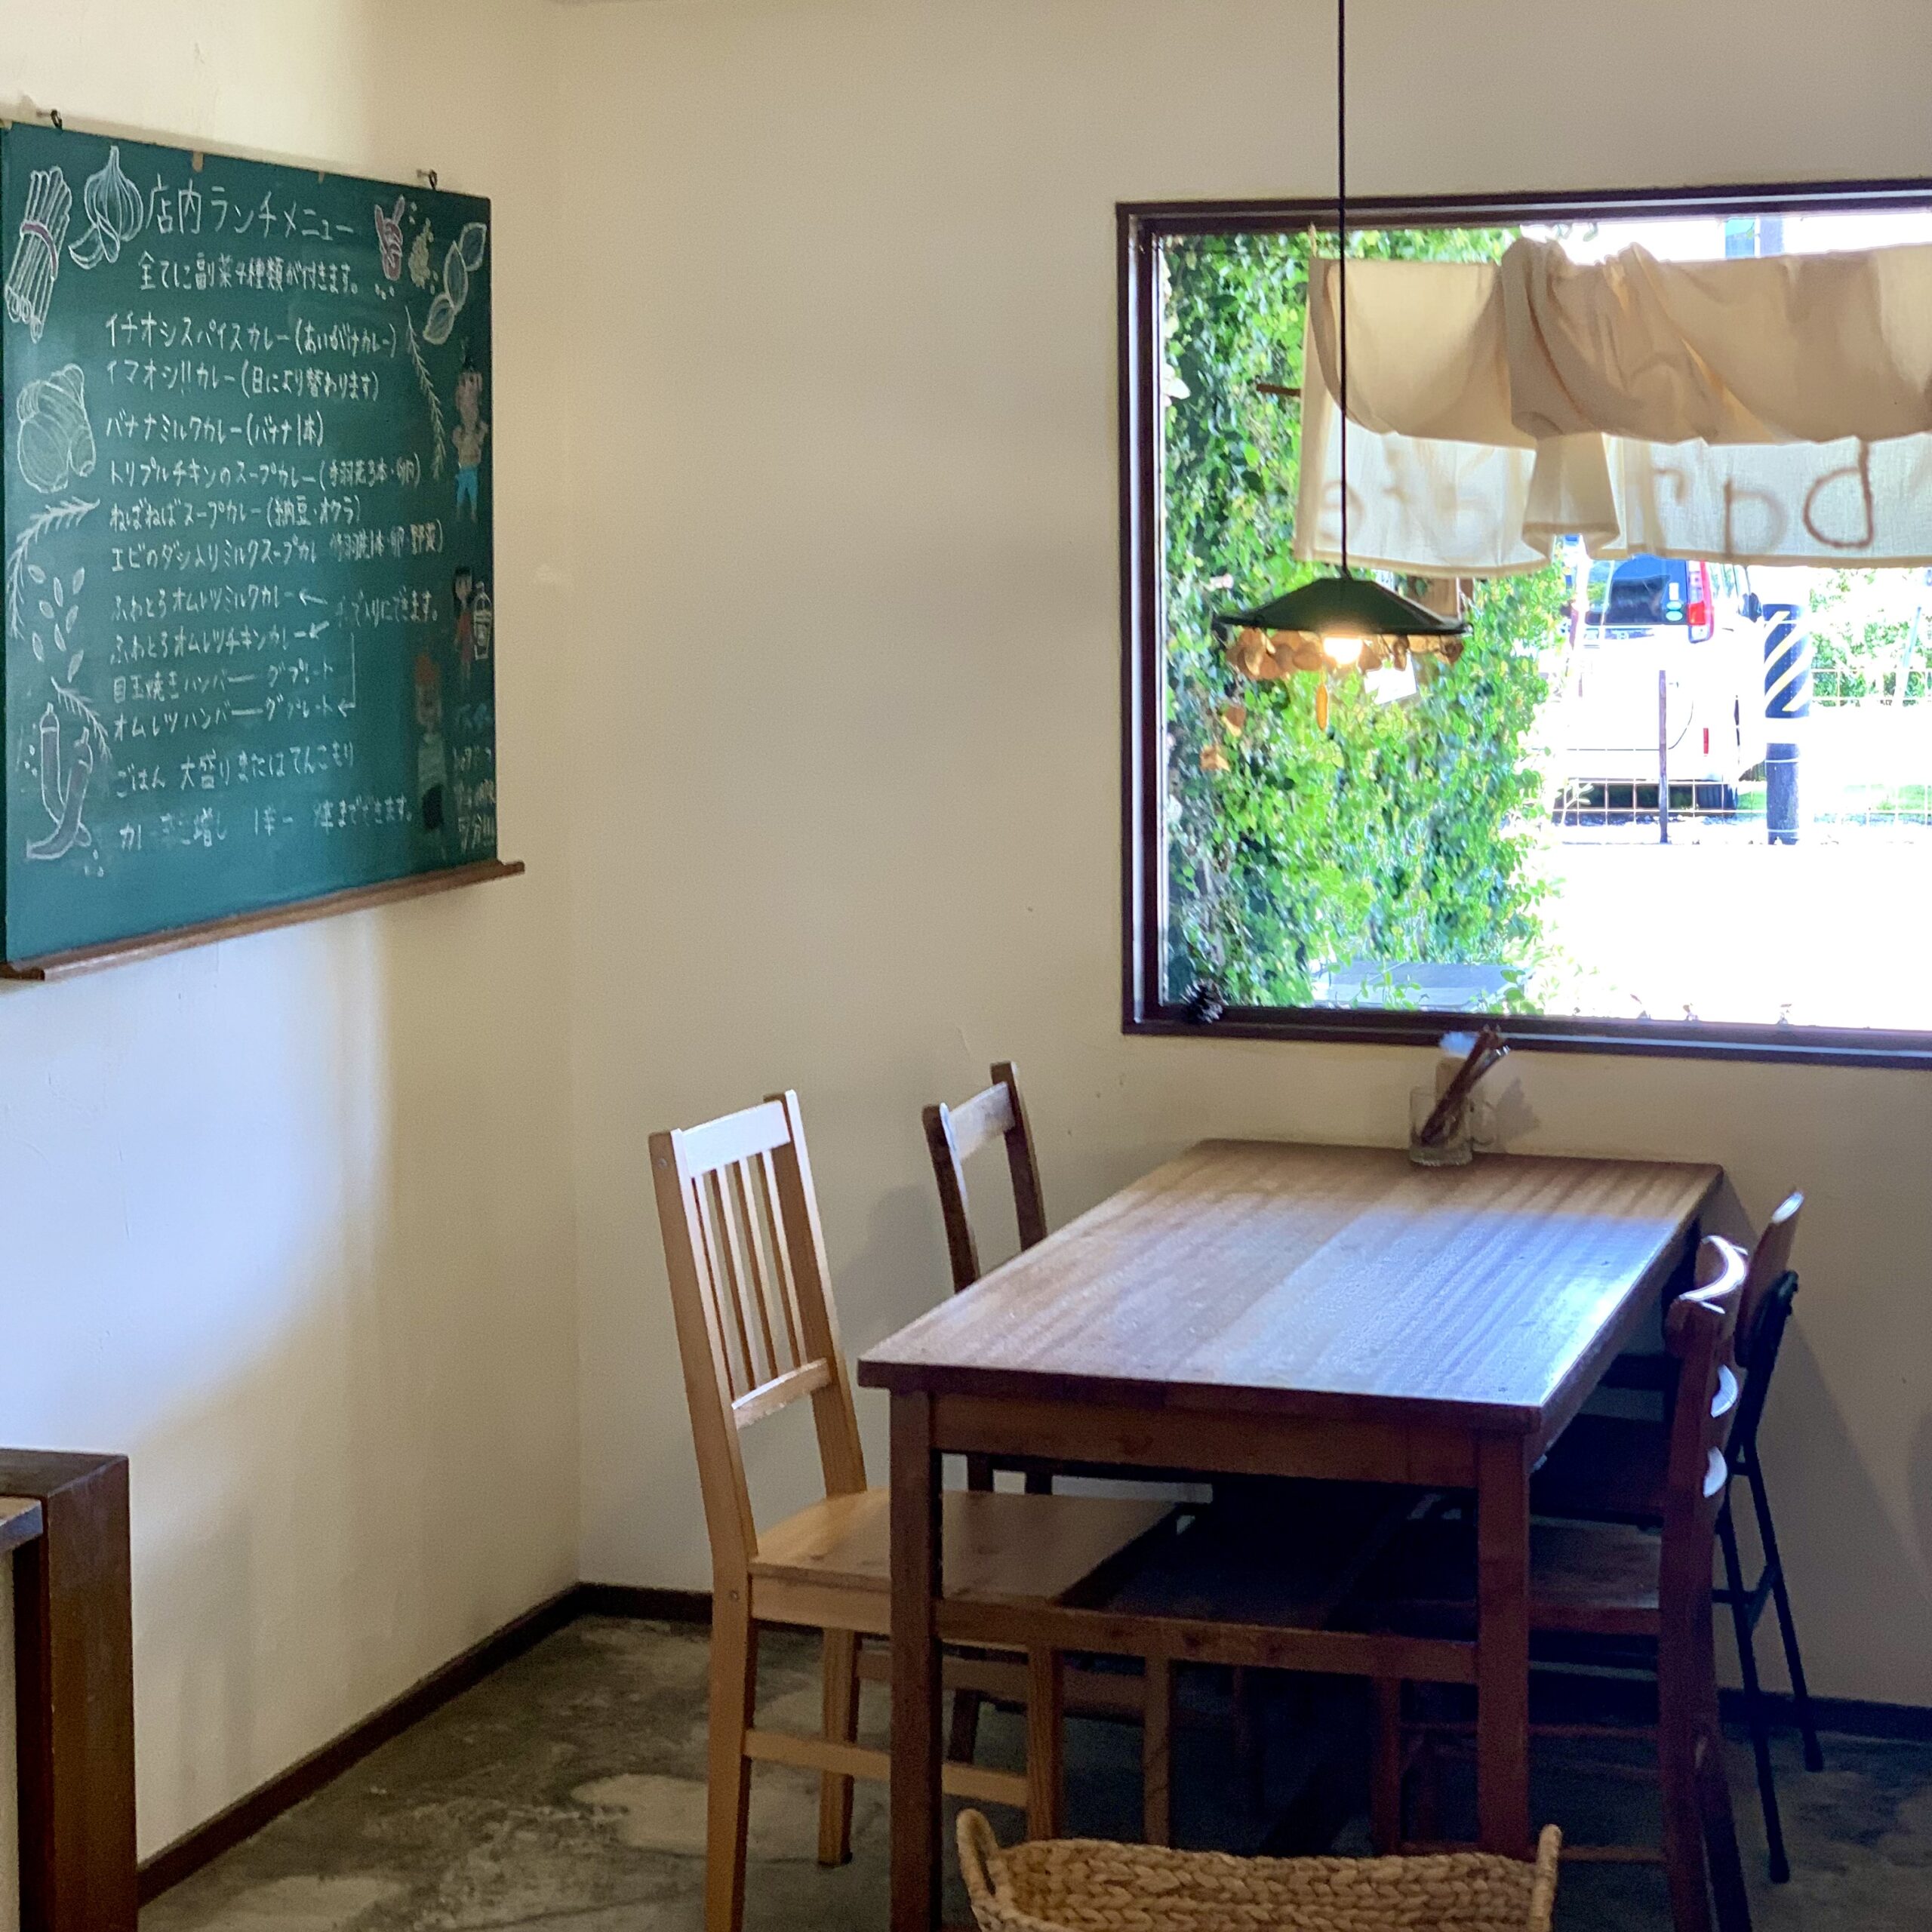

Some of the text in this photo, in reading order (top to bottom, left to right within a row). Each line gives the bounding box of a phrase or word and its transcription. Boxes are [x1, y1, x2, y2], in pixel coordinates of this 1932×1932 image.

[145, 172, 355, 242] 店内ランチメニュー
